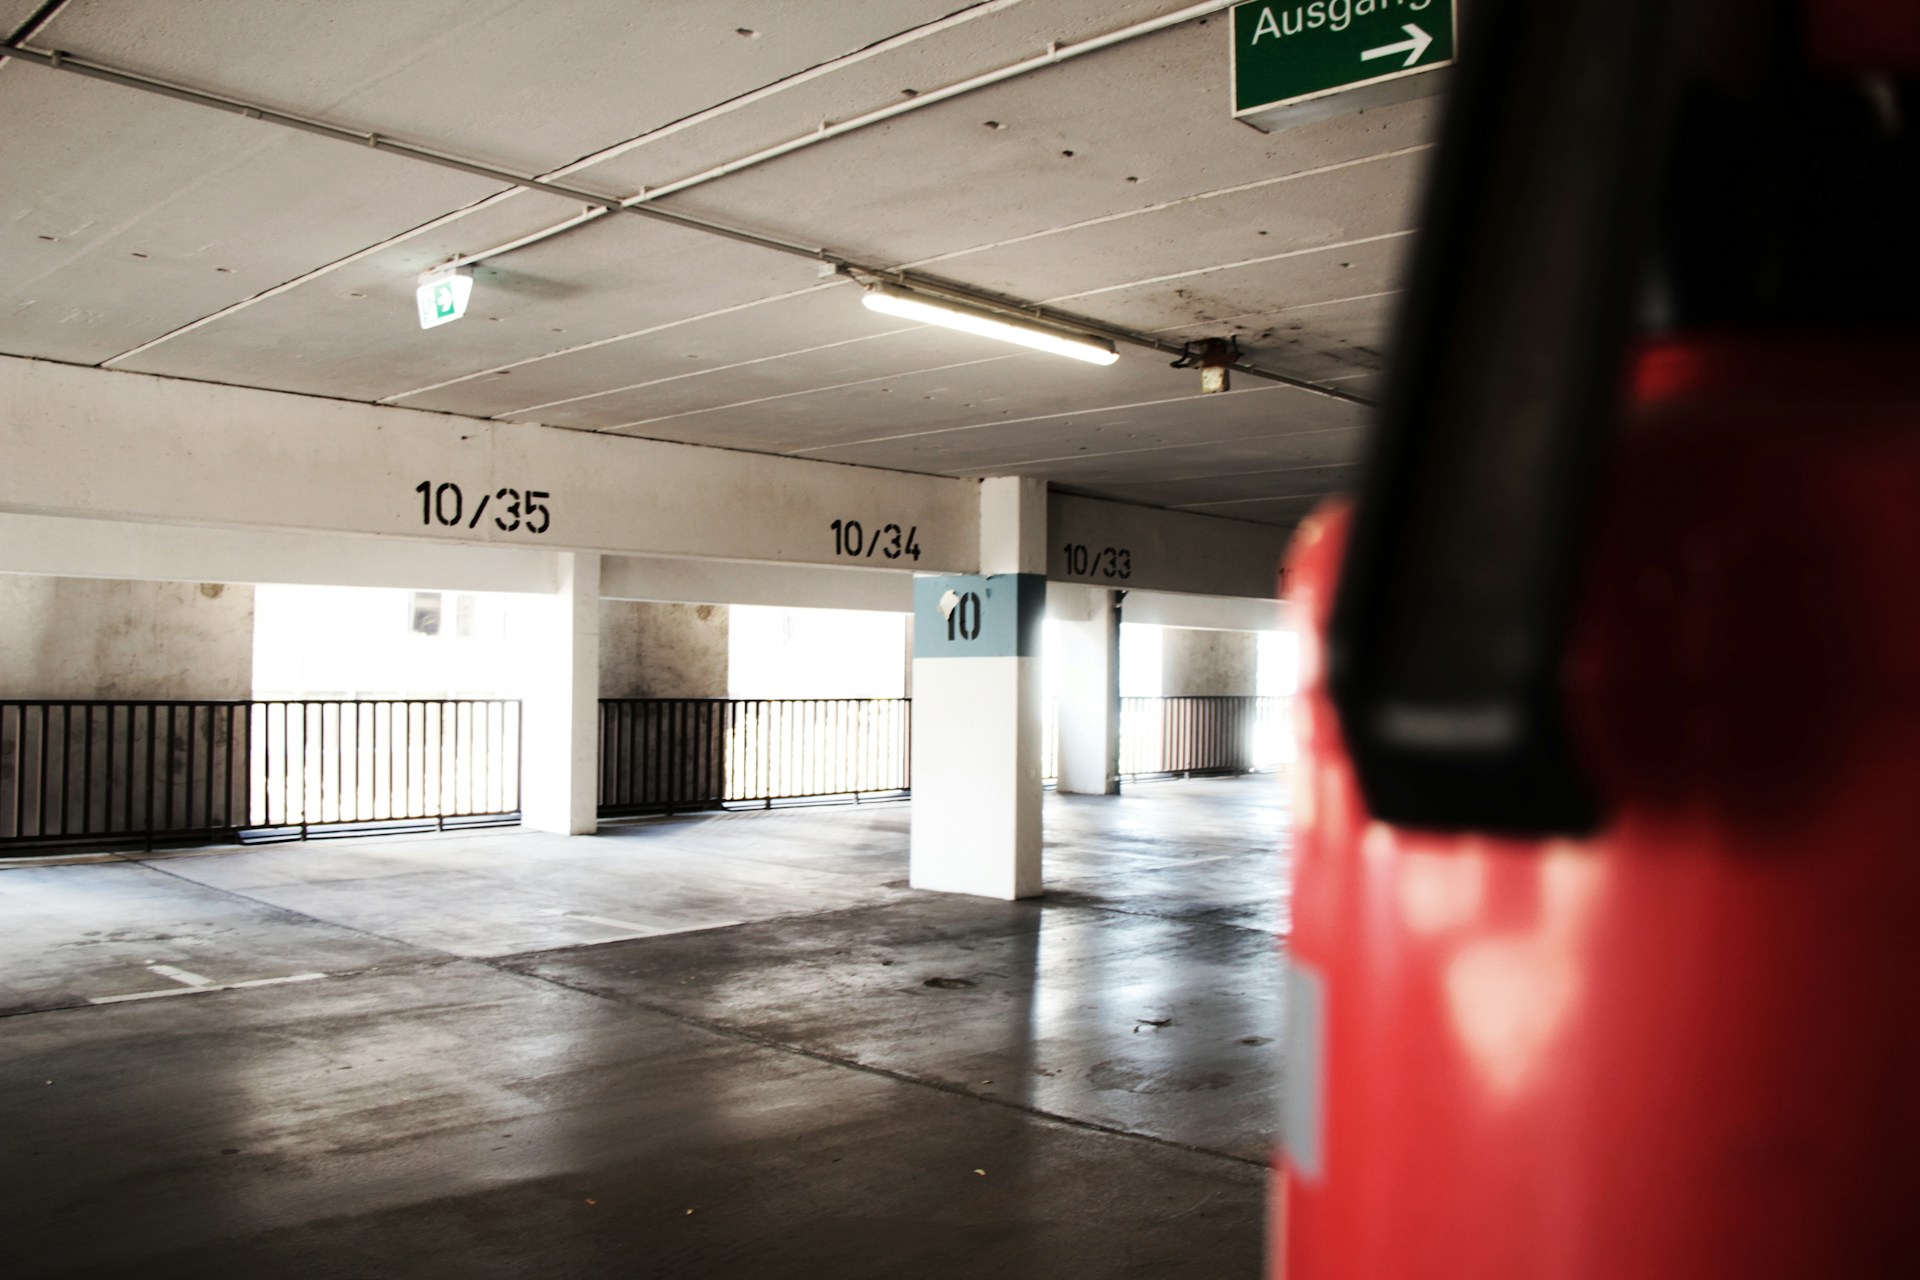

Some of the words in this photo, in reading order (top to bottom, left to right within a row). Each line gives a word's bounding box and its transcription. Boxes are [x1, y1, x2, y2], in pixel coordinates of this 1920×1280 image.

[415, 480, 550, 534] 10/35
[830, 519, 921, 561] 10/34
[1063, 543, 1131, 579] 10/33
